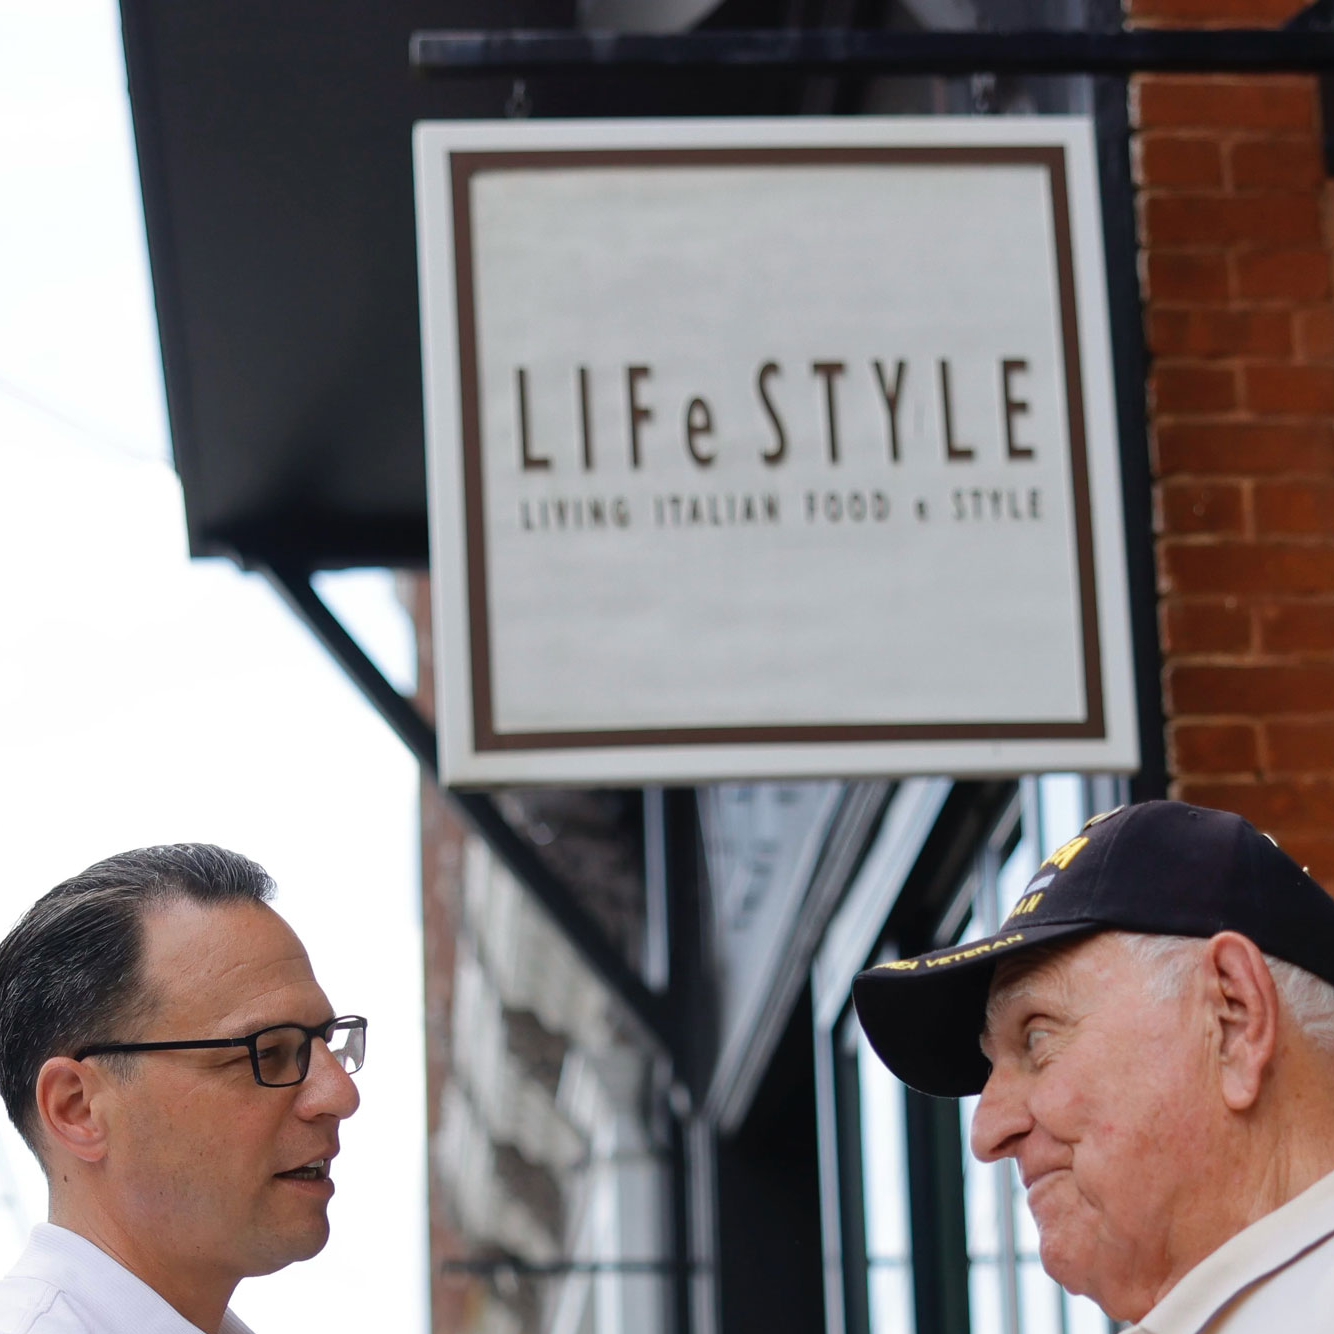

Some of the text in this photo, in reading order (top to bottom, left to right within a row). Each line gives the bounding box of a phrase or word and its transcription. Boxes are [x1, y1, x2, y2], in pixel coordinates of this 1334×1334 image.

[516, 357, 1038, 473] LIFe STYLE
[520, 495, 630, 532] LIVING
[655, 493, 780, 527] ITALIAN
[804, 491, 893, 525] FOOD
[951, 489, 1044, 522] STYLE
[926, 934, 1024, 968] VETERAN
